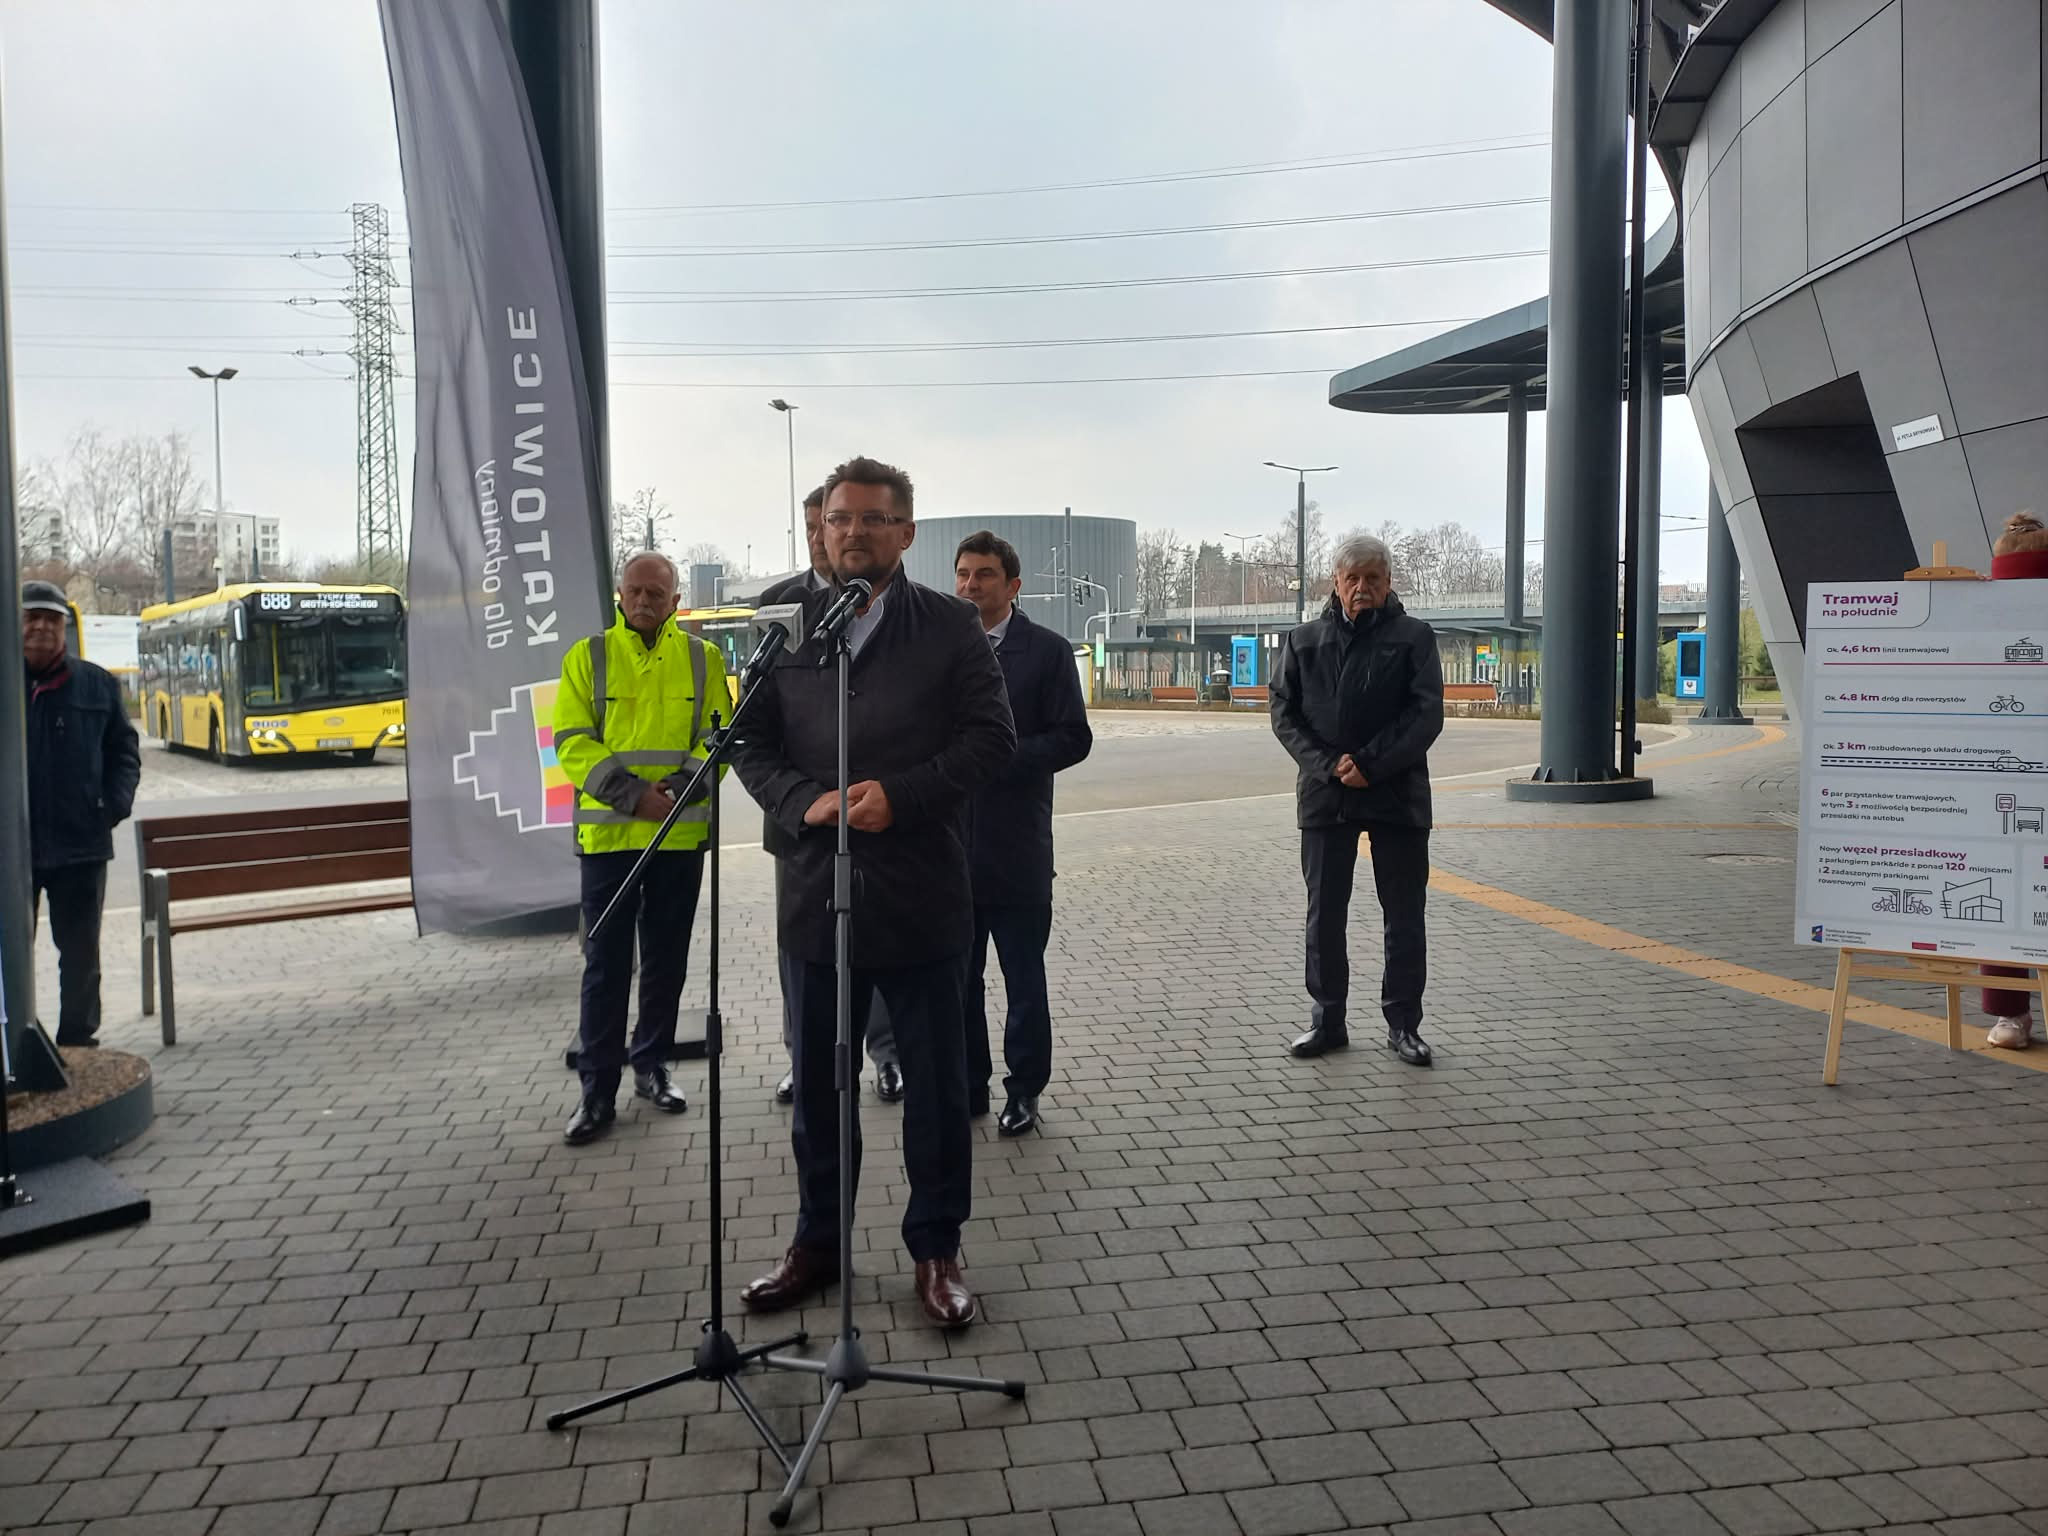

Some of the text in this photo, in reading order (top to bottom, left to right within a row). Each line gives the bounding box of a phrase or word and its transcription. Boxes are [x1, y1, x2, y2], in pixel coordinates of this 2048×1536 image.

[261, 593, 291, 610] 688
[1822, 592, 1899, 606] Tramwaj
[1822, 607, 1898, 618] na południe
[1841, 645, 1859, 654] 4,6
[1862, 645, 1881, 653] km
[1861, 693, 1879, 701] km
[1881, 695, 1900, 703] dróg
[1837, 742, 1845, 750] 3
[1847, 742, 1866, 750] km
[1868, 745, 1932, 753] rozbudowanego
[1933, 746, 1962, 754] układu
[1963, 748, 2012, 756] drogowego
[1822, 788, 1829, 797] 6
[1844, 791, 1894, 800] przystanków
[1895, 793, 1957, 802] tramwajowych,
[1829, 801, 1845, 809] tym
[1846, 800, 1853, 809] 3
[1861, 803, 1909, 812] możliwością
[1910, 805, 1968, 815] bezpośredniej
[1820, 812, 1860, 820] przesiadki
[1819, 845, 1967, 861] Nowy węzeł przesiadkowy
[1825, 857, 1869, 866] parkingiem
[1870, 860, 1909, 868] park&ride
[1917, 863, 1944, 871] ponad
[1945, 862, 1966, 871] 120
[1968, 866, 2012, 875] miejscami
[1822, 866, 1830, 874] 2
[1831, 868, 1882, 878] zadaszonymi
[1883, 872, 1929, 881] parkingami
[1818, 878, 1866, 887] rowerowymi
